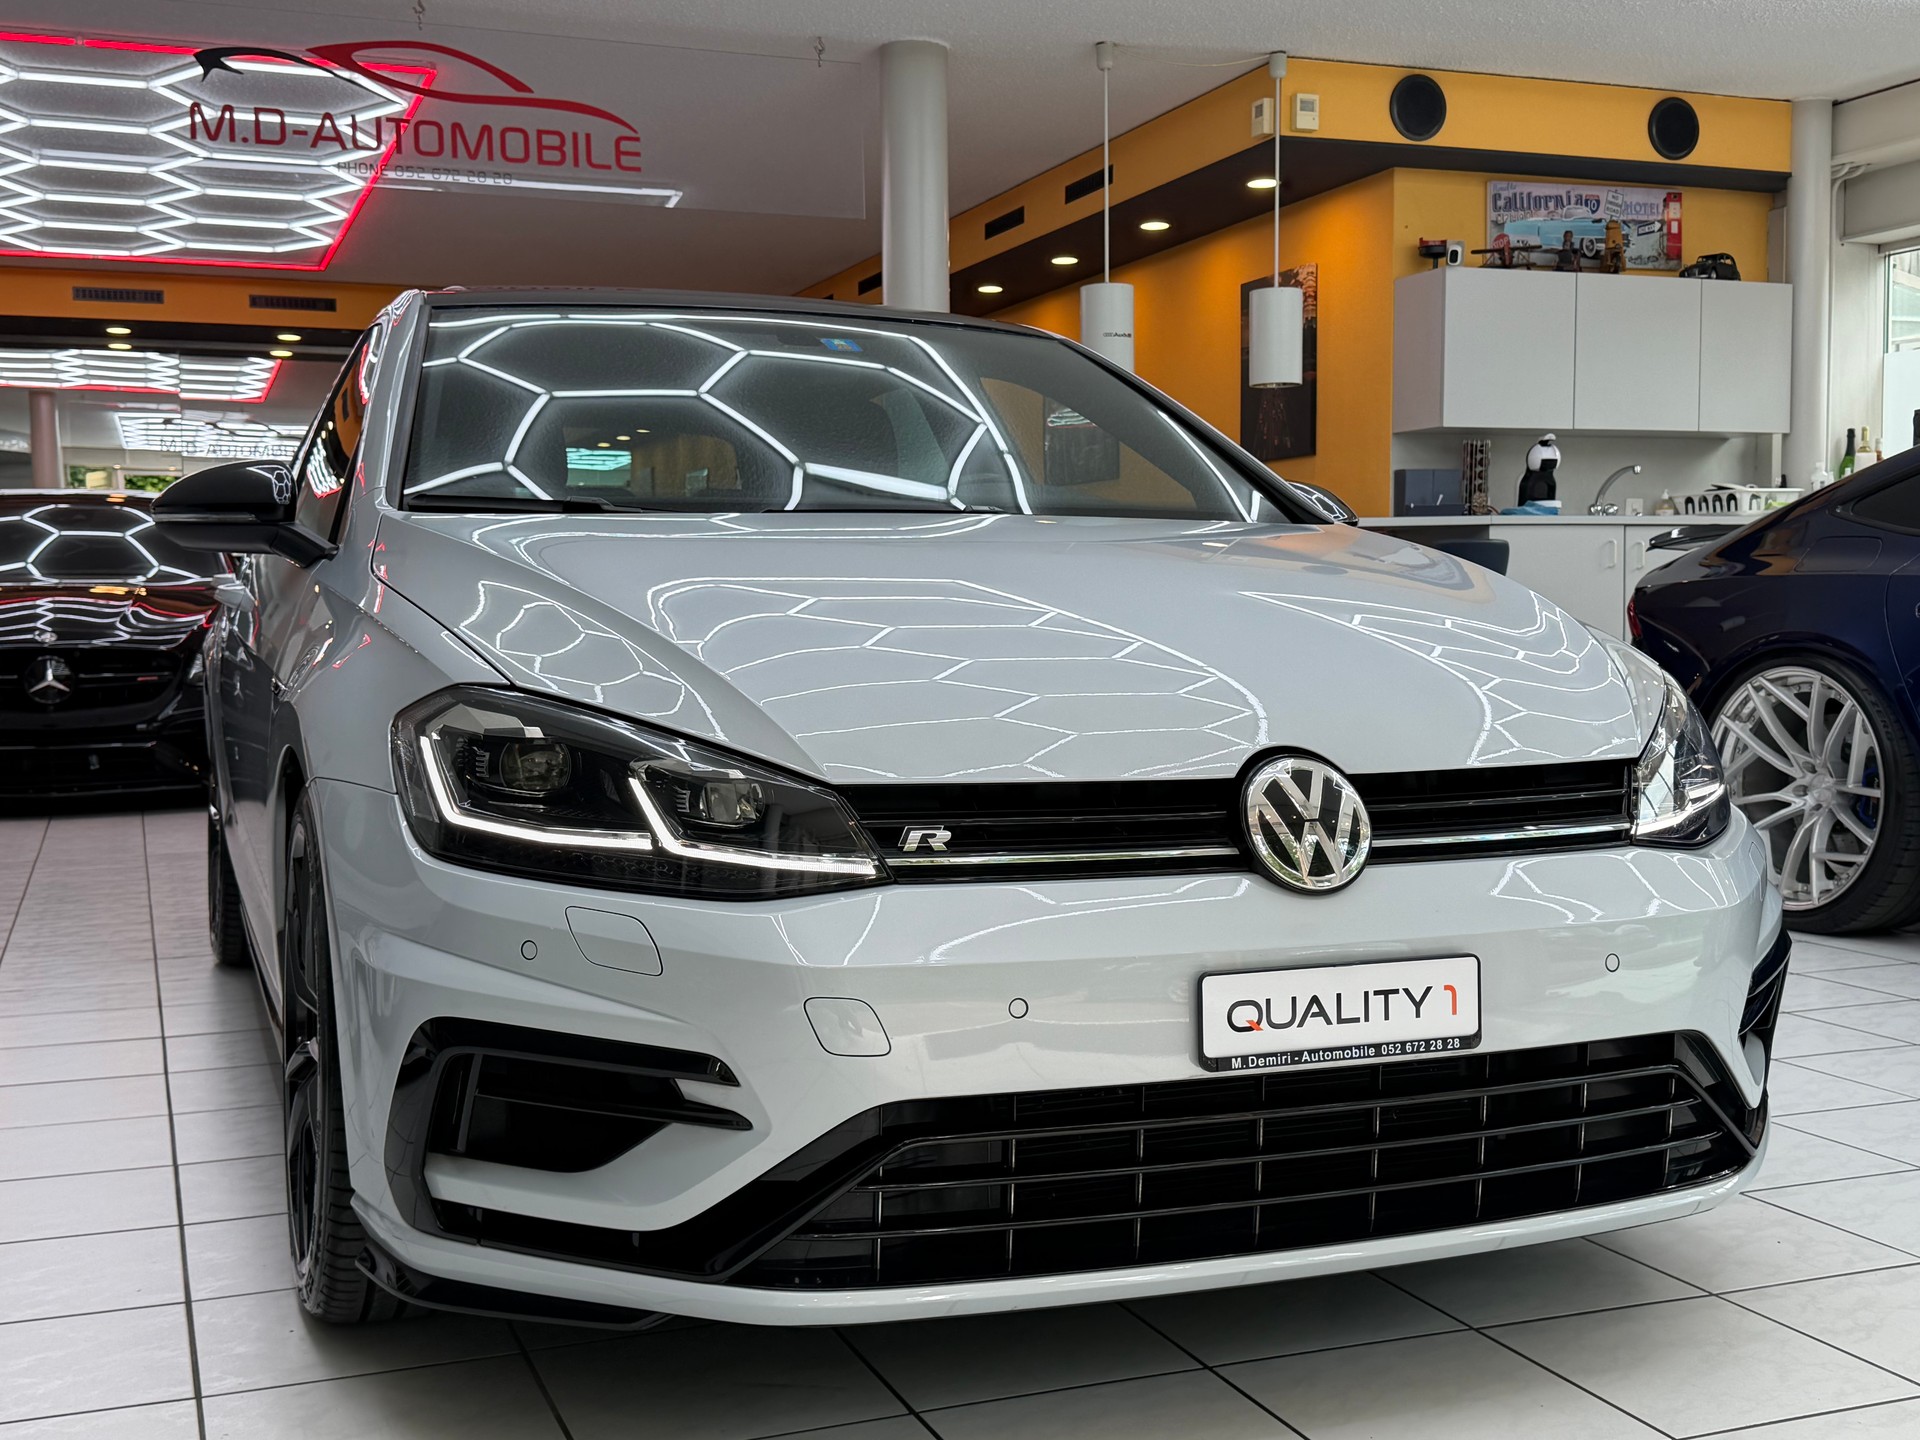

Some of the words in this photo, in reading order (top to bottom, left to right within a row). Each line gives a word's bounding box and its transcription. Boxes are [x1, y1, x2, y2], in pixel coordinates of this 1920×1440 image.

[190, 101, 642, 173] M.D-AUTOMOBILE
[337, 161, 389, 176] PHONE
[395, 165, 426, 179] 052
[1491, 189, 1584, 213] California
[902, 828, 952, 852] R
[1226, 985, 1433, 1033] QUALITY
[1443, 984, 1457, 1015] 1
[1301, 1045, 1376, 1062] Automobile
[1381, 1043, 1402, 1055] 052
[1406, 1041, 1426, 1052] 672
[1430, 1039, 1443, 1051] 28
[1447, 1038, 1460, 1049] 28
